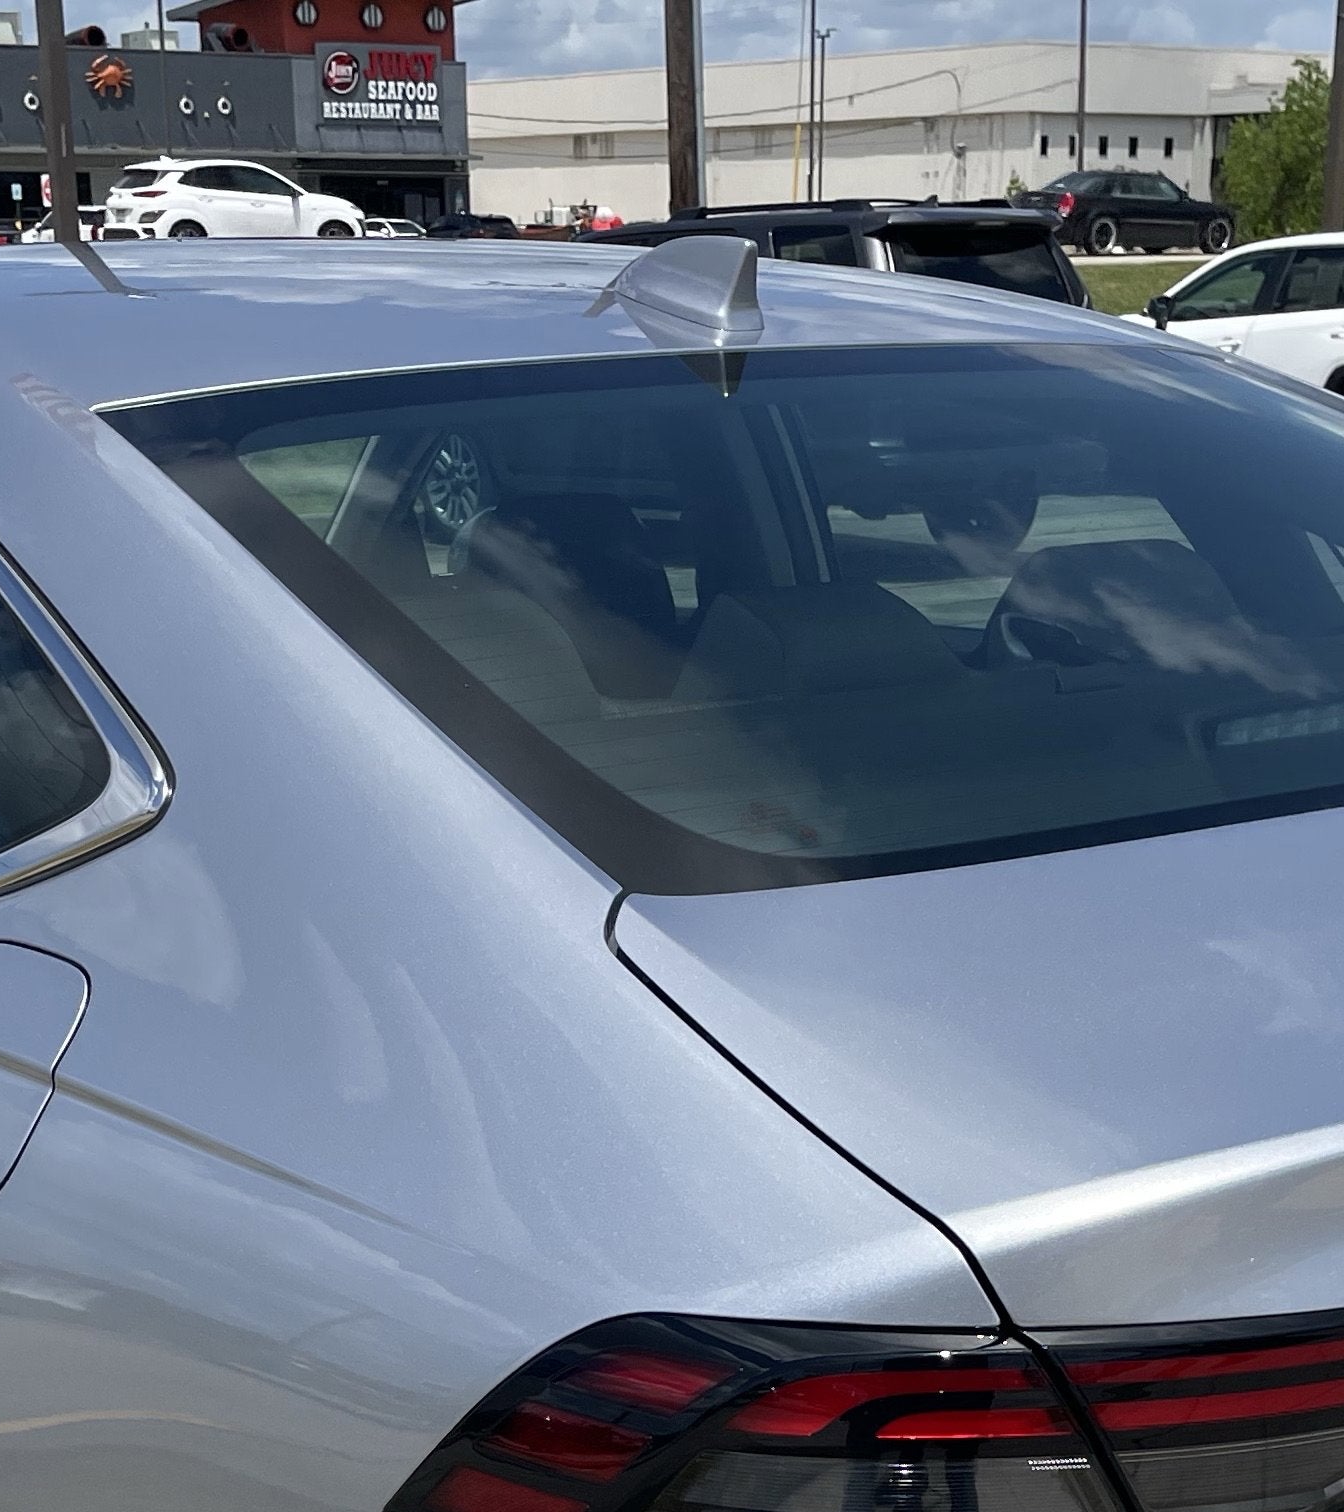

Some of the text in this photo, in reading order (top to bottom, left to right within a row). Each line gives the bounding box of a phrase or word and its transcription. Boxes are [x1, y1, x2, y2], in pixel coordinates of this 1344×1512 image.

[363, 51, 435, 80] JUICY
[367, 80, 438, 101] SEAFOOD
[322, 102, 440, 121] RESTAURANT & BAR
